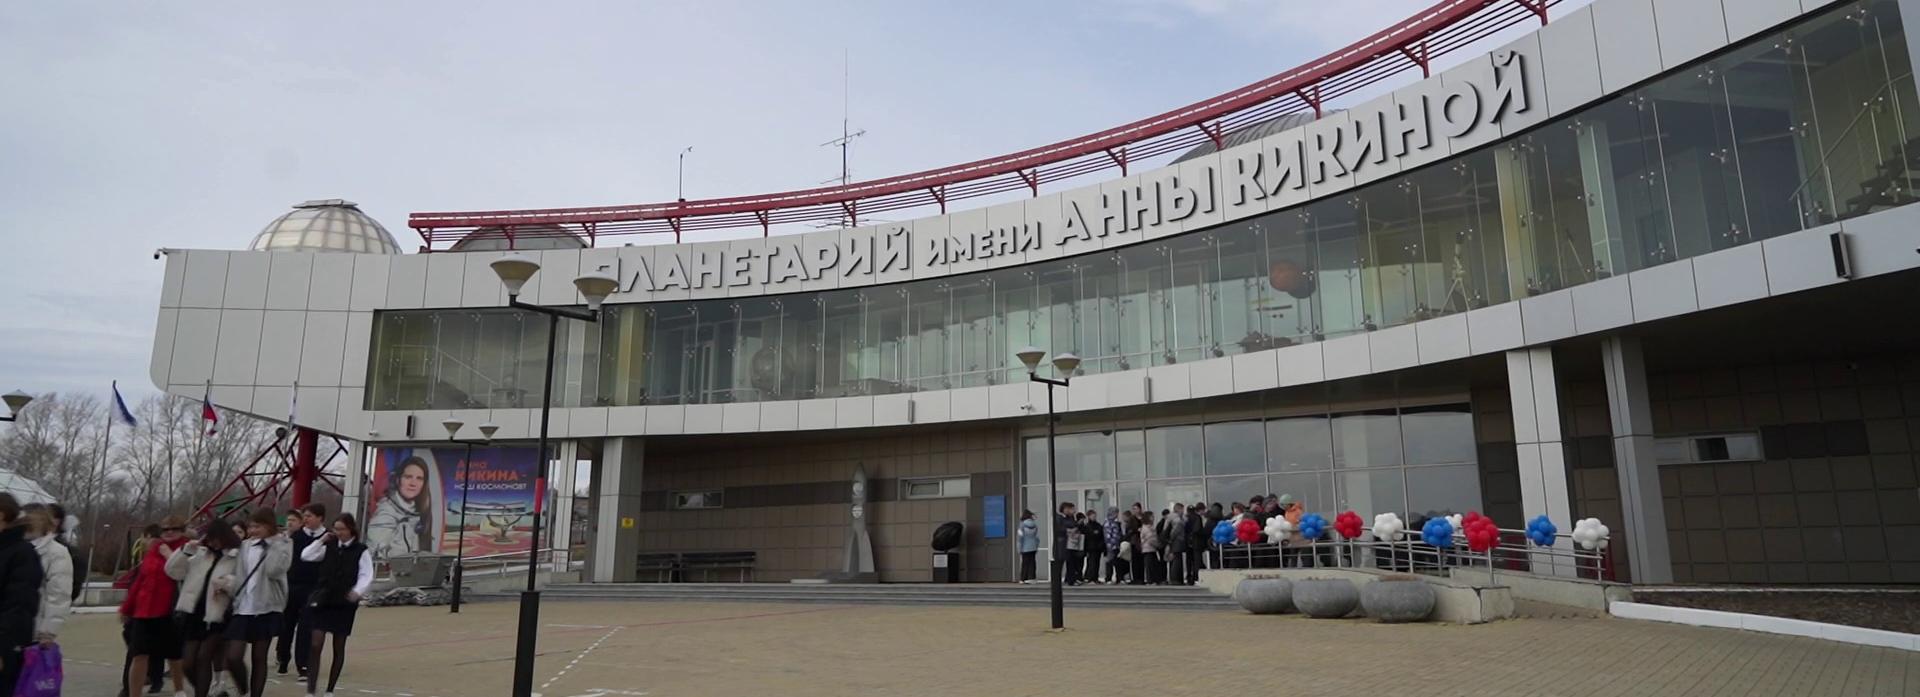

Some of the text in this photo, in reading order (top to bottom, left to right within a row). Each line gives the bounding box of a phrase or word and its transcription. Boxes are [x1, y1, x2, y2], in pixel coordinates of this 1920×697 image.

[927, 220, 1042, 266] ИМЕНИ
[1054, 166, 1215, 246] АННЫ
[1230, 49, 1529, 207] КИКИНОЙ
[456, 459, 486, 468] Ана
